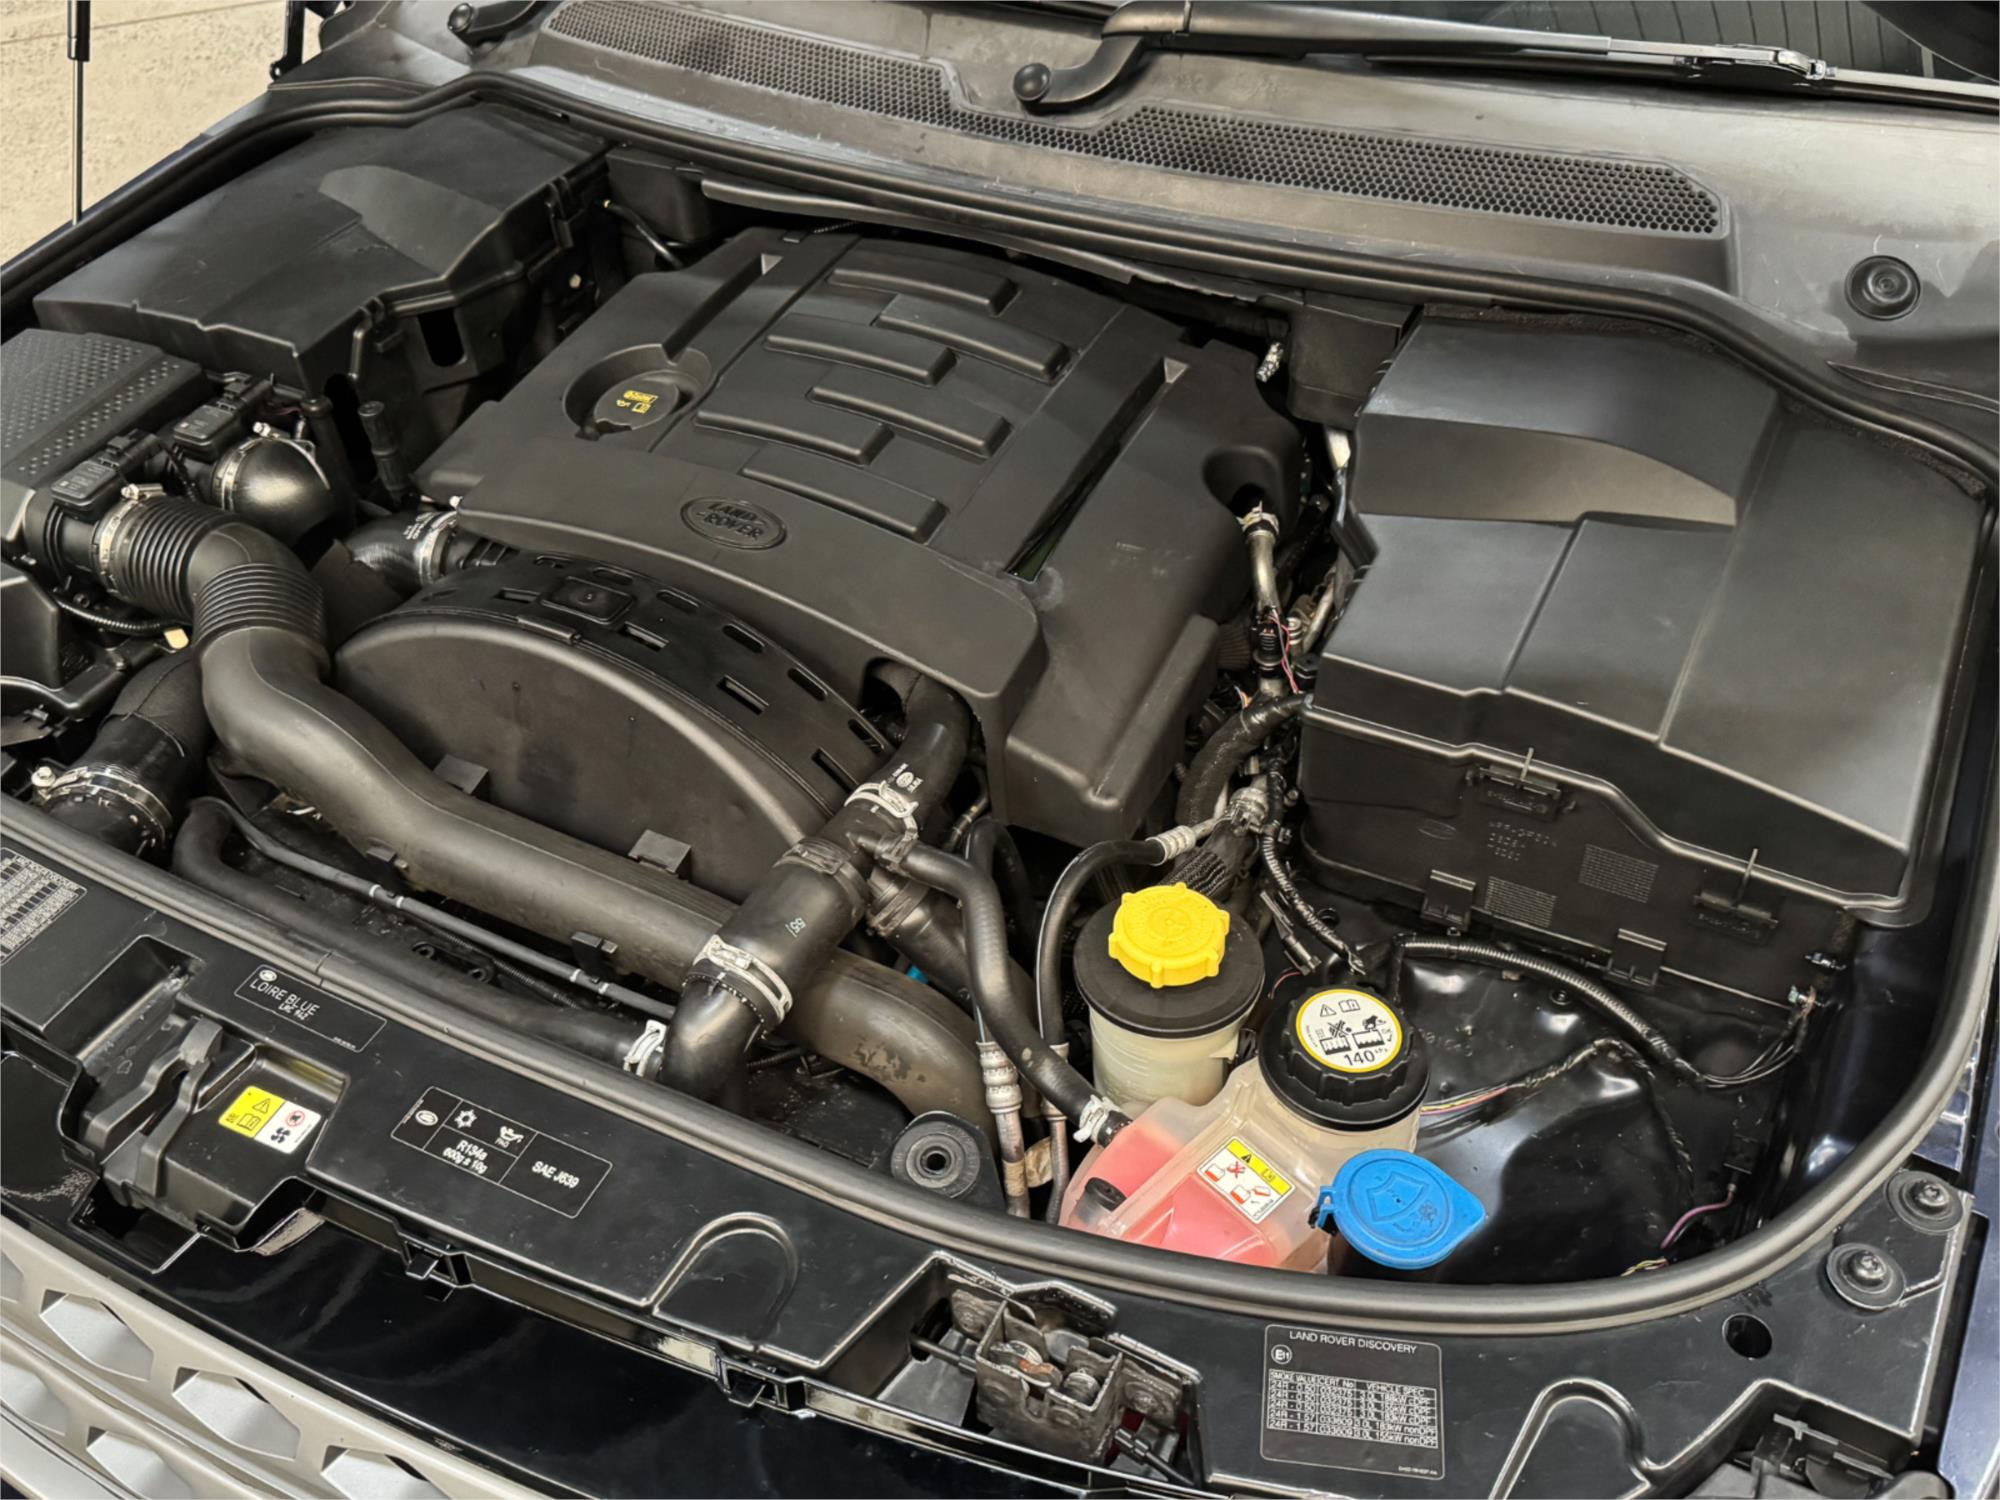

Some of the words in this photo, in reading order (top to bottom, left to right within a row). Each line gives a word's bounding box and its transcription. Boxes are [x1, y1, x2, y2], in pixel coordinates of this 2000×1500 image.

[707, 503, 758, 521] LAND
[703, 513, 764, 540] ROVER
[249, 978, 288, 1000] LOIRE
[284, 993, 320, 1016] BLUE
[1344, 1050, 1376, 1066] 140
[456, 1139, 488, 1161] R134a
[532, 1161, 557, 1178] SAE
[553, 1168, 580, 1189] J639
[1289, 1330, 1318, 1342] LAND
[1320, 1334, 1356, 1346] ROVER
[1358, 1339, 1417, 1354] DISCOVERY
